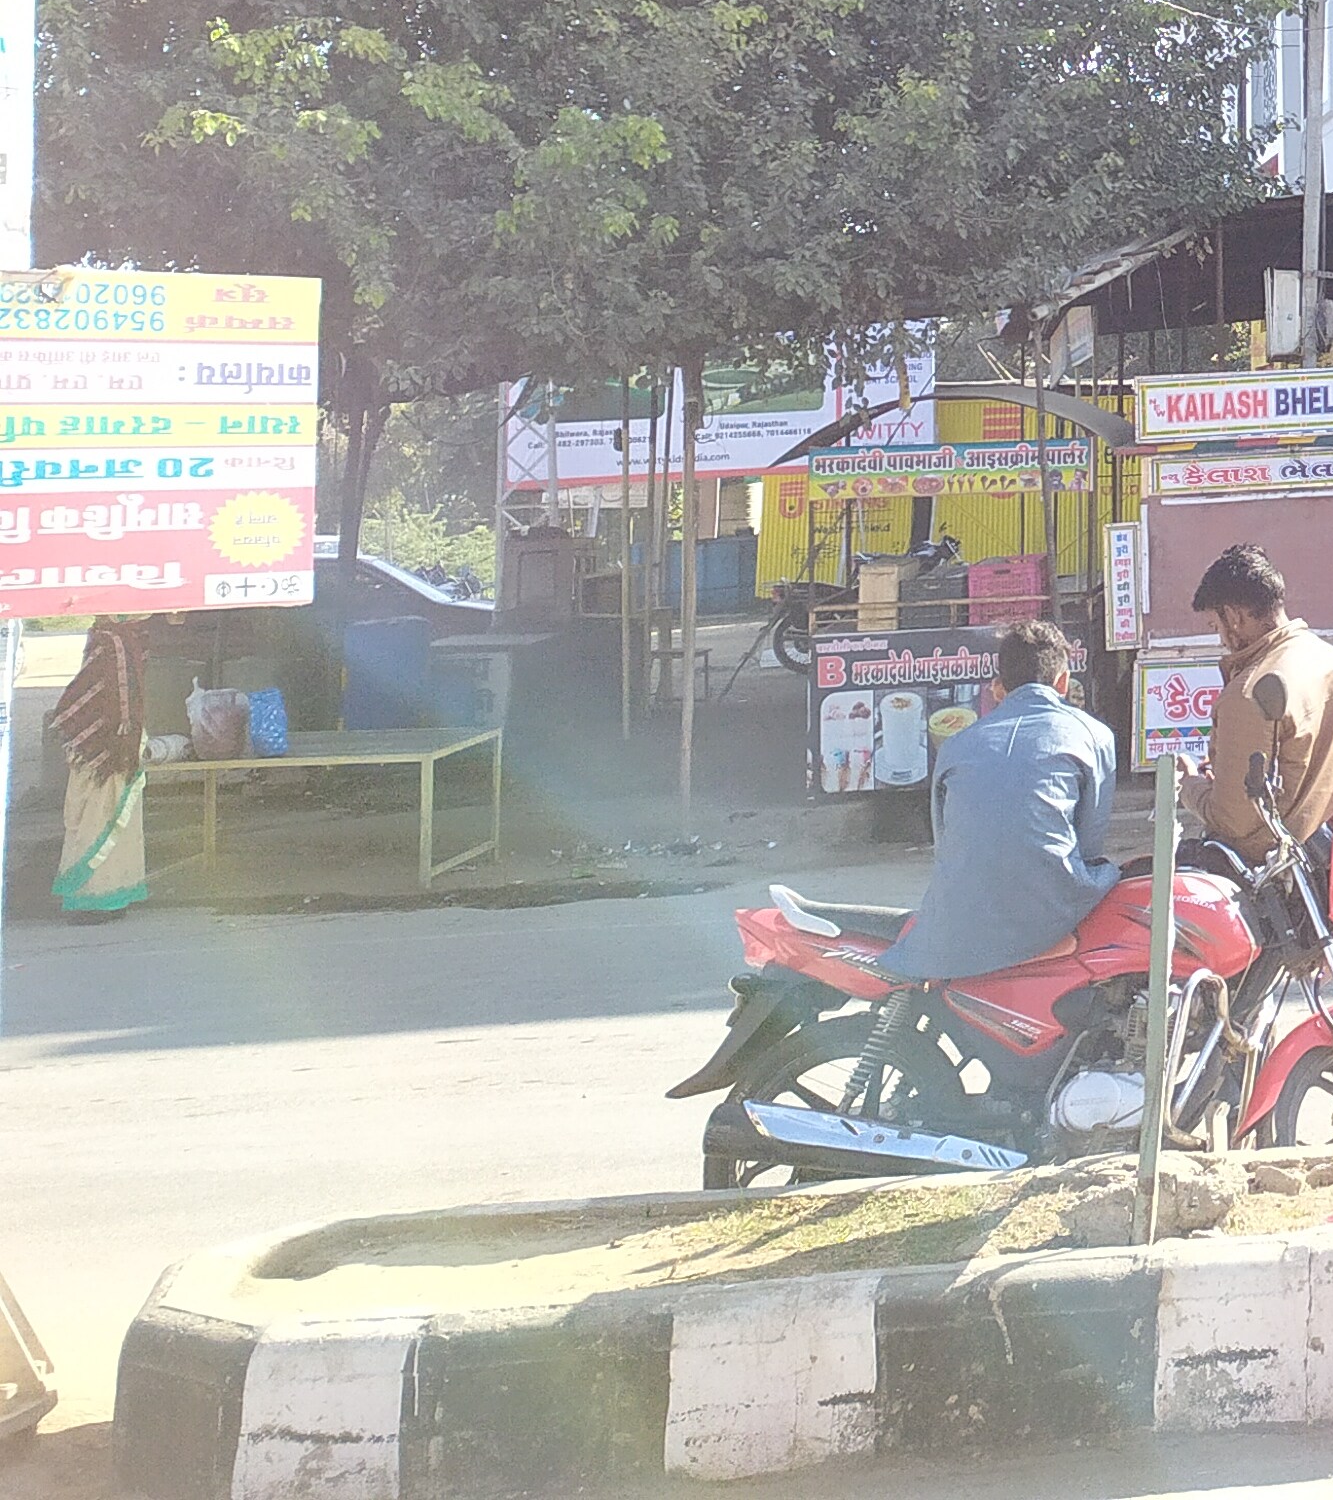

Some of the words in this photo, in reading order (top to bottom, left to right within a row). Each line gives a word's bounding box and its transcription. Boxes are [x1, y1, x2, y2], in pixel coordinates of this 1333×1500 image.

[193, 363, 312, 393] कार्यालय
[1166, 389, 1269, 423] KAILASH
[56, 416, 173, 436] दरगाह
[218, 416, 302, 436] स्थान
[751, 420, 788, 430] Rajasthan
[157, 457, 214, 479] 20
[814, 447, 884, 475] भरकादेवी
[887, 445, 954, 471] पावभाजी
[965, 444, 1041, 469] आइसक्रीम
[1183, 463, 1271, 486] કૈલાશ
[36, 494, 205, 541] सामूहिक
[818, 656, 846, 688] B
[852, 649, 914, 685] भरकादेवी
[982, 652, 993, 679] &
[1164, 673, 1224, 721] કૈલ
[1184, 735, 1205, 751] पानी
